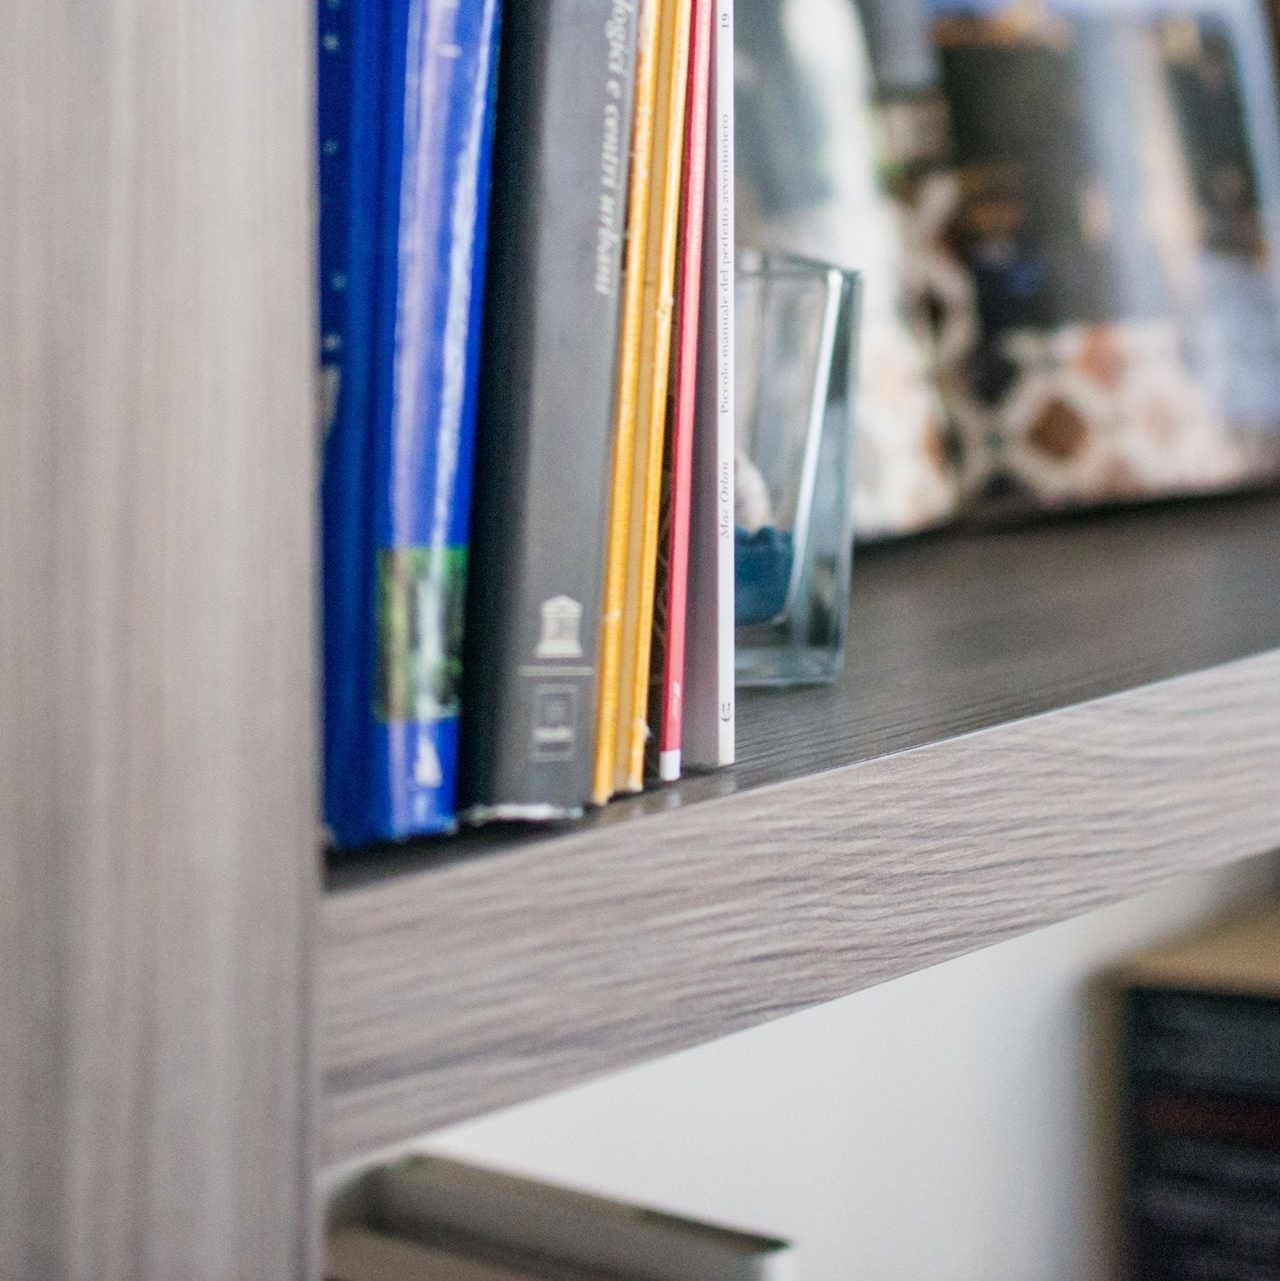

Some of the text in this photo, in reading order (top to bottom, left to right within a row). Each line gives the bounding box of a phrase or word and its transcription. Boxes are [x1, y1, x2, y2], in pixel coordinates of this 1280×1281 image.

[721, 12, 730, 29] 19
[600, 103, 623, 192] centri
[593, 193, 620, 295] urbani
[720, 113, 731, 414] Piccolo manuale del perfetto avventuriero
[720, 462, 730, 539] Mac Orlan
